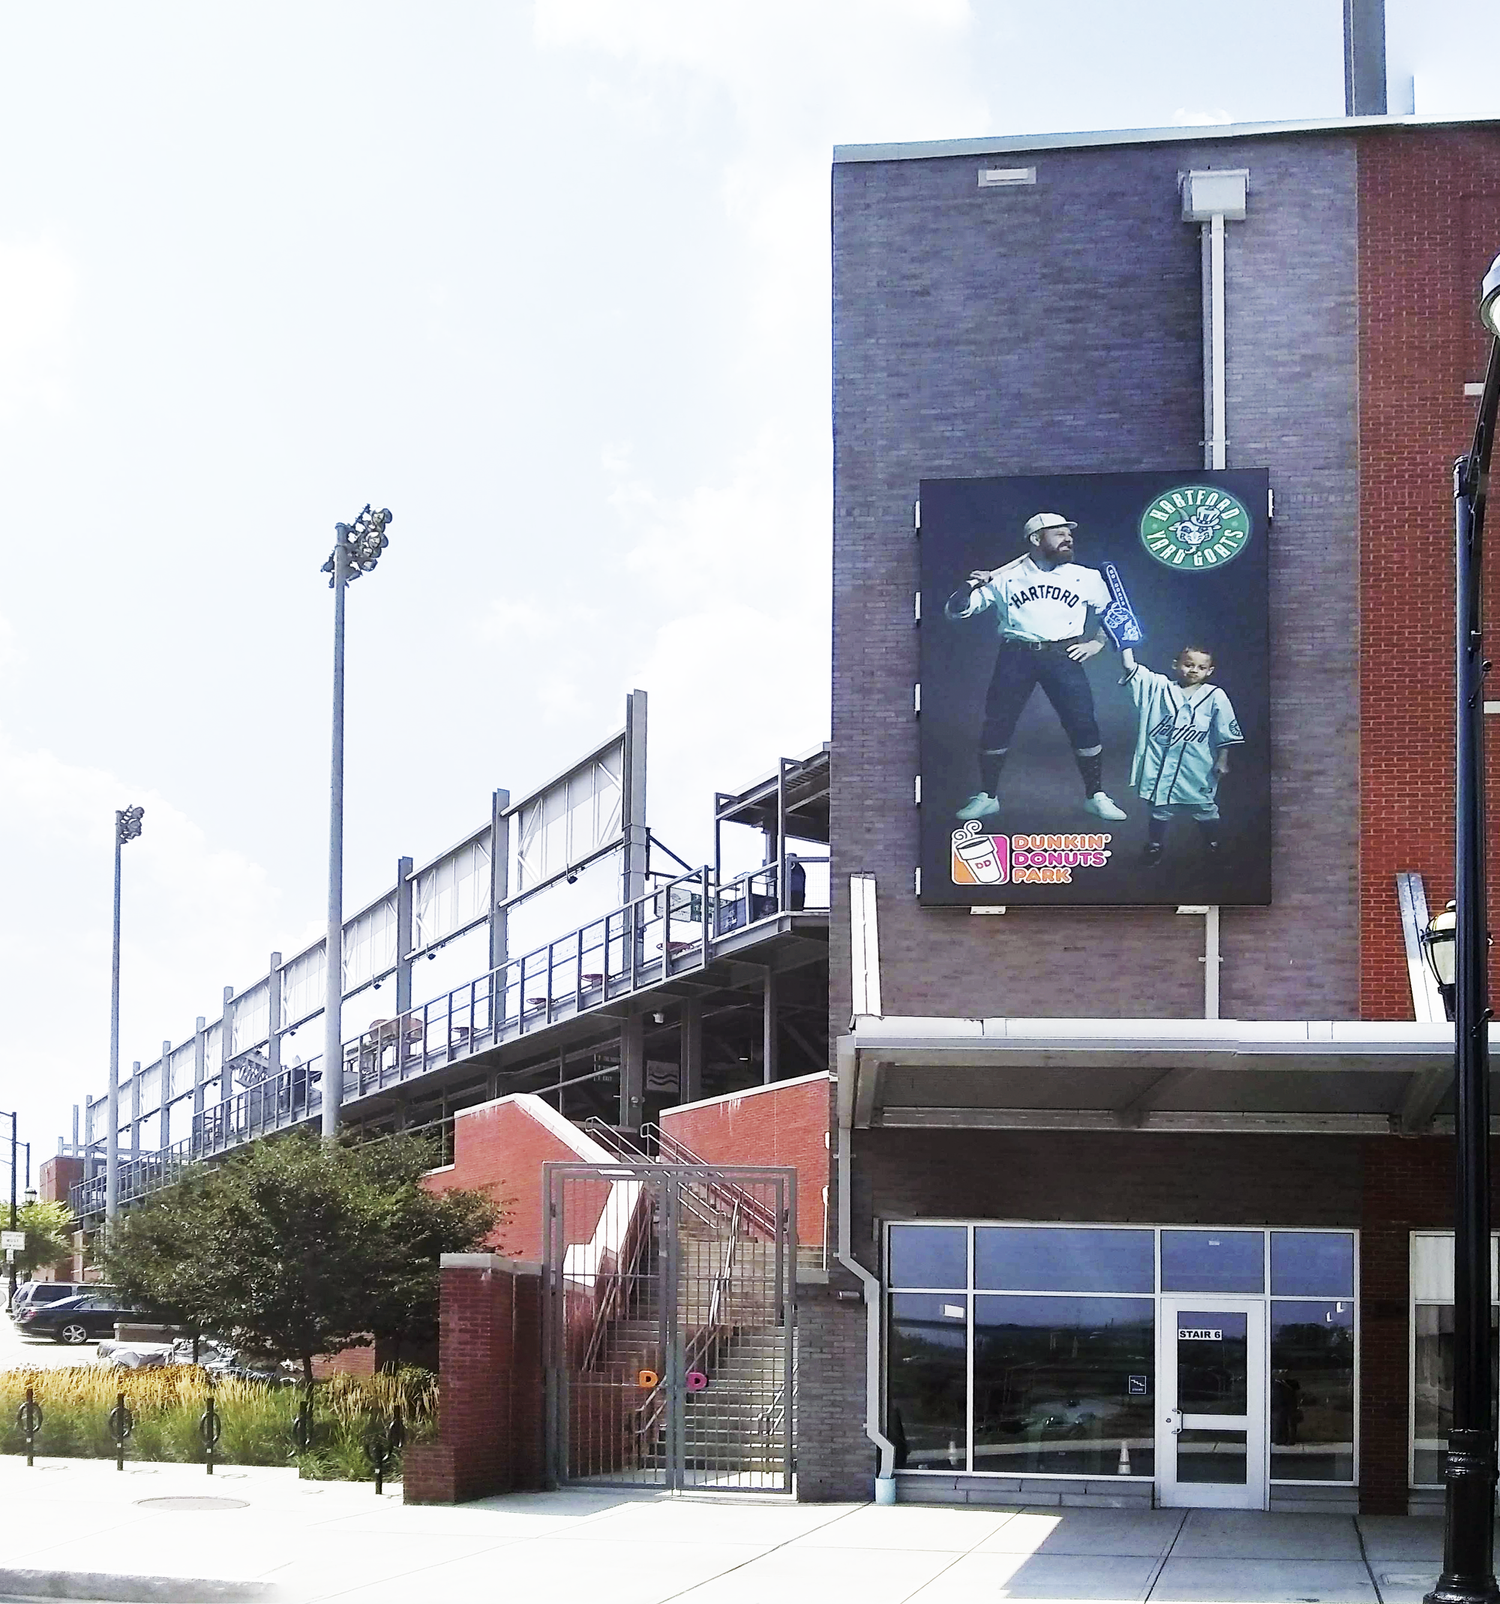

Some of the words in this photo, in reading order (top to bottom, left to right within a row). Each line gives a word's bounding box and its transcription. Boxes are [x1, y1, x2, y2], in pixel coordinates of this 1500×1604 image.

[1149, 489, 1240, 522] HARTFORD
[1146, 530, 1187, 564] YARD
[1193, 529, 1244, 566] GOATS
[1011, 584, 1080, 609] HARTFORD
[1012, 834, 1111, 850] DUNKIN'
[974, 859, 992, 870] DD
[1012, 851, 1107, 867] DONUTS
[1012, 868, 1072, 883] PARK
[1179, 1330, 1211, 1338] STAIR
